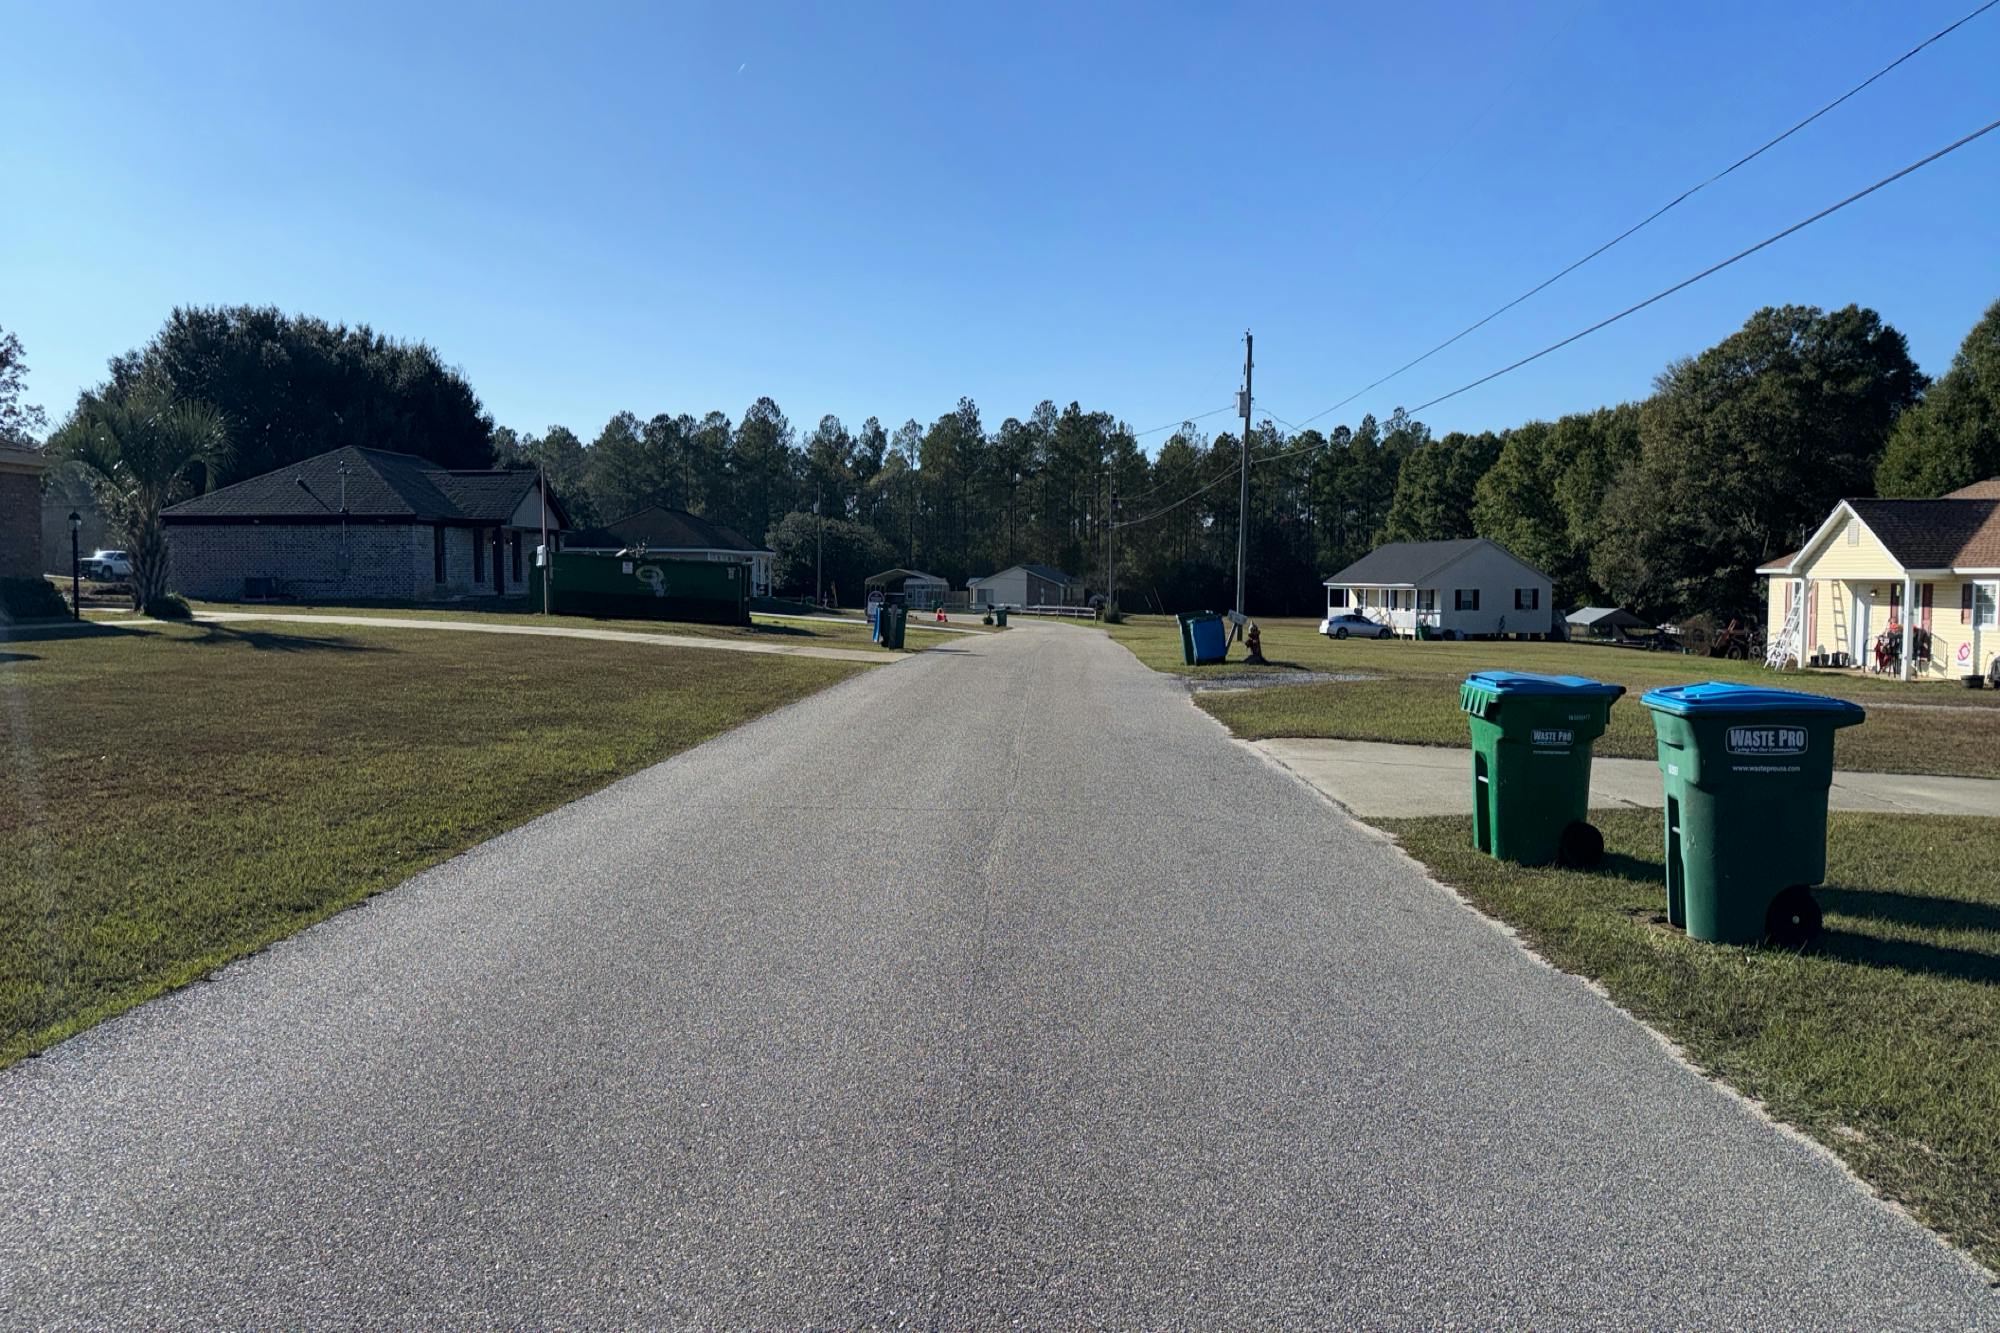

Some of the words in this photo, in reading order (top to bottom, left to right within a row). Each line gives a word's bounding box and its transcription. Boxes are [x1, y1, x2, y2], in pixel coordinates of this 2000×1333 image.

[1533, 730, 1556, 741] WASTE
[1558, 731, 1572, 741] PRO
[1730, 729, 1775, 747] WASTE
[1779, 729, 1805, 747] PRO
